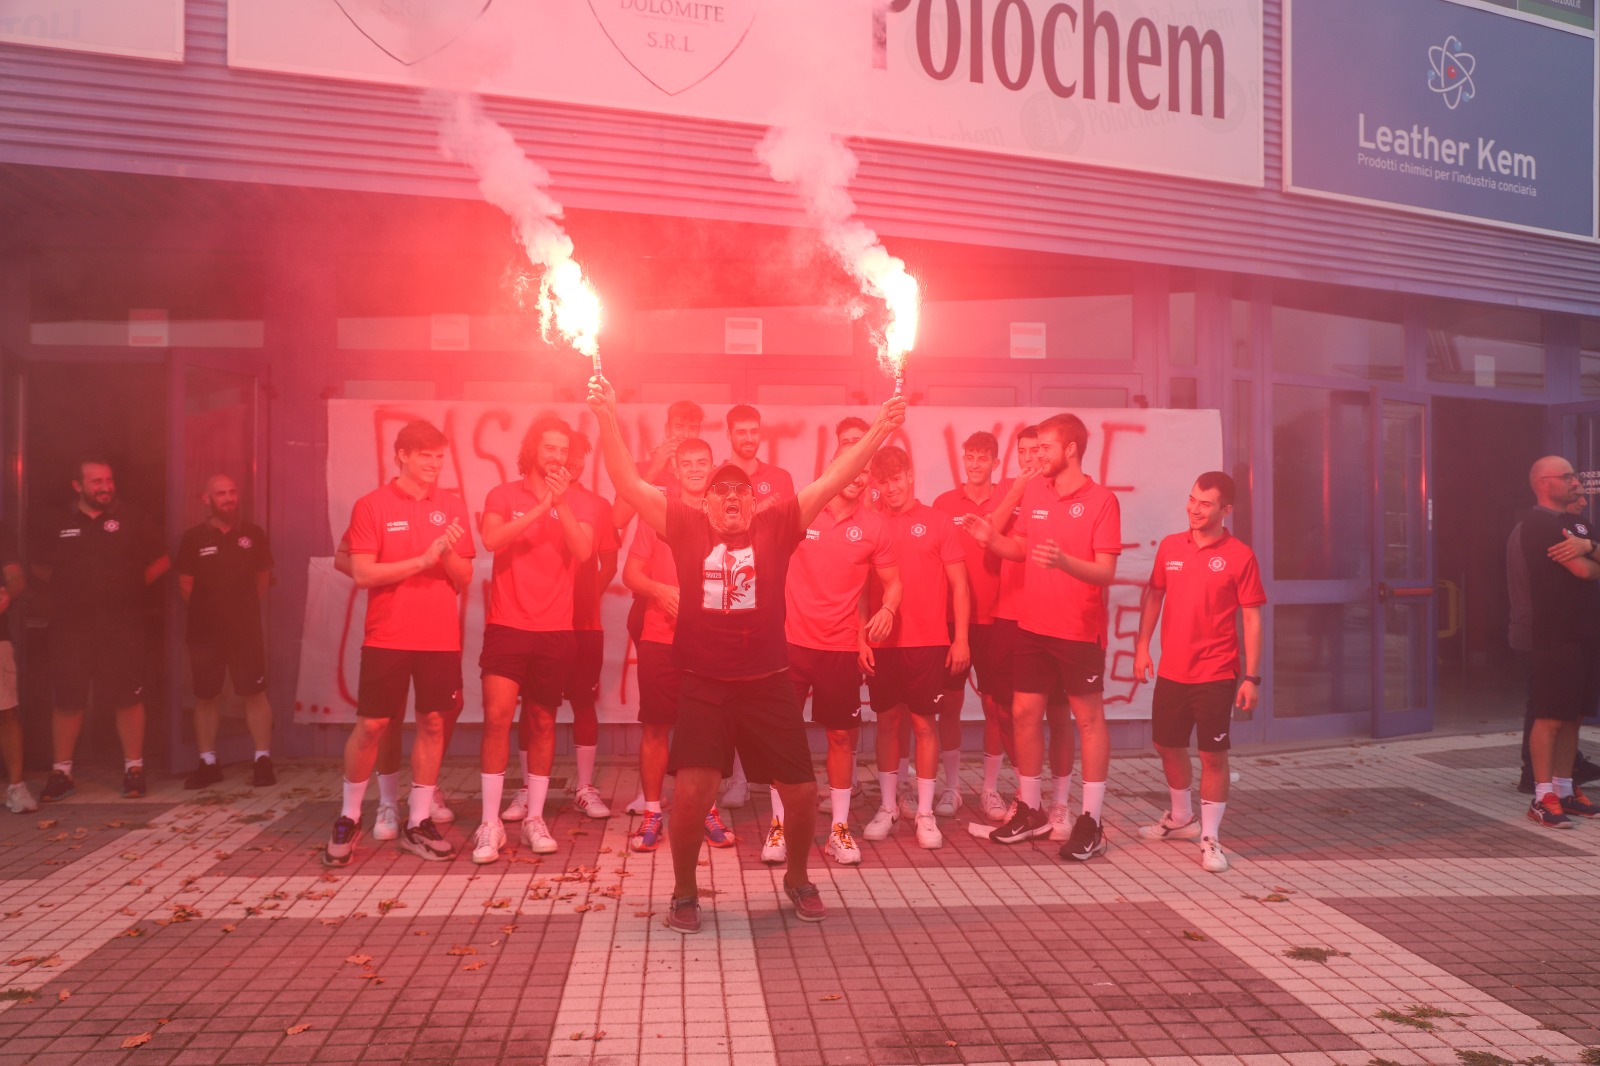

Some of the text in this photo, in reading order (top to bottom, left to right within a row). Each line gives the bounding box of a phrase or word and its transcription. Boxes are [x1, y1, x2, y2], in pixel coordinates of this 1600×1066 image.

[620, 0, 725, 22] DOLOMITE
[1358, 112, 1537, 180] Leather Kem
[1358, 153, 1537, 197] Prodotti chimici per l'industria conciaria
